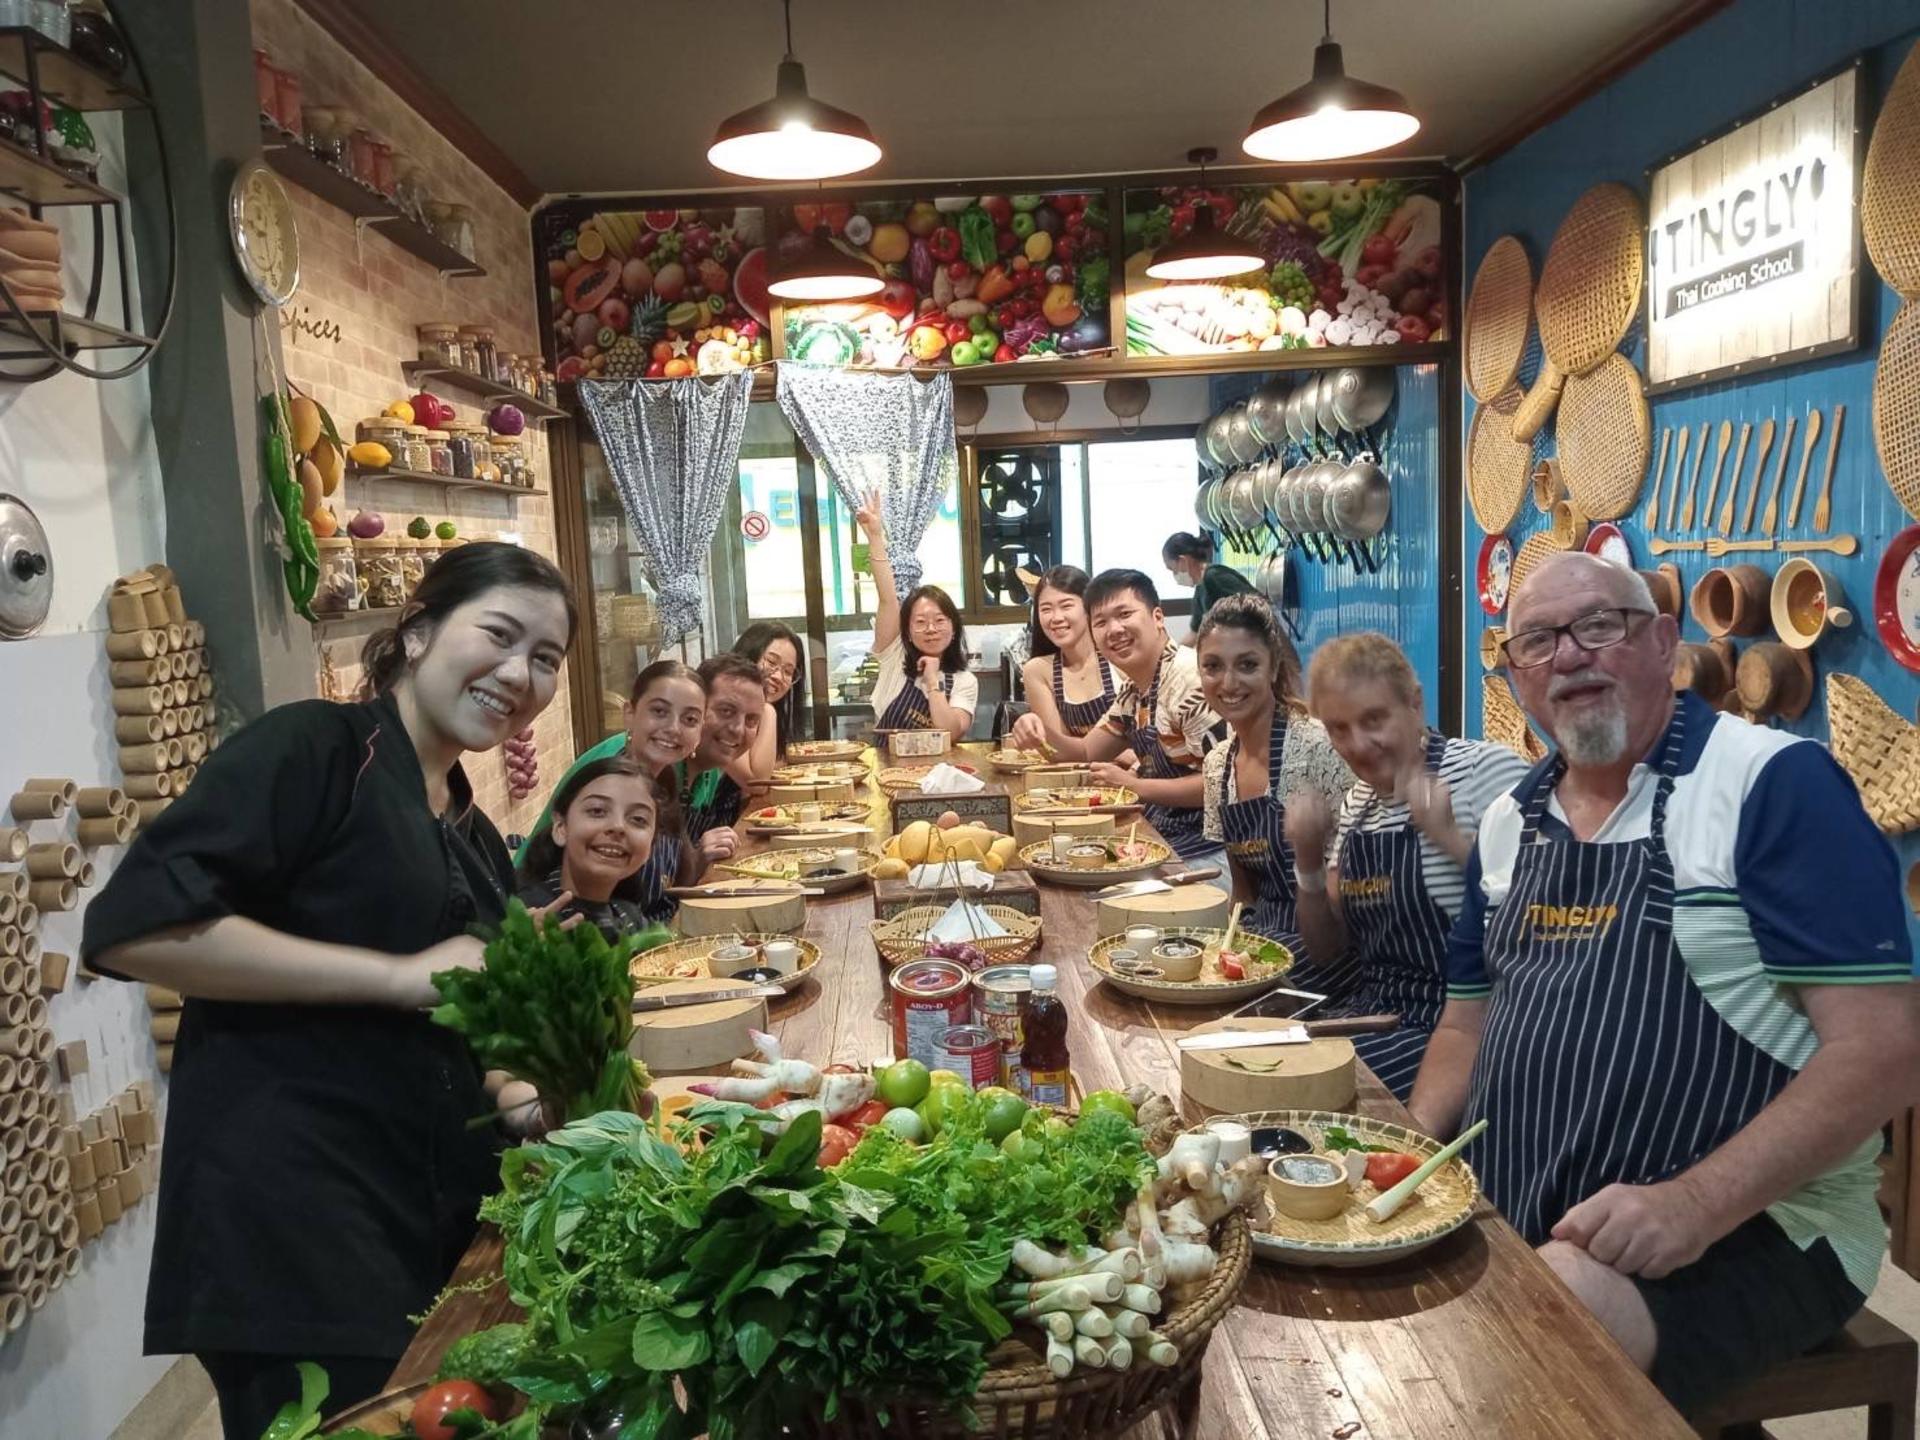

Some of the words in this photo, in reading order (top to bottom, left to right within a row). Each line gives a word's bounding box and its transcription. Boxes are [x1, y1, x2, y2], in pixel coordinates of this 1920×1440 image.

[1665, 164, 1803, 274] TINGLY
[1676, 285, 1699, 309] Thai
[1701, 271, 1747, 300] Cooking
[1750, 250, 1794, 285] School
[1530, 905, 1607, 927] TINGLY
